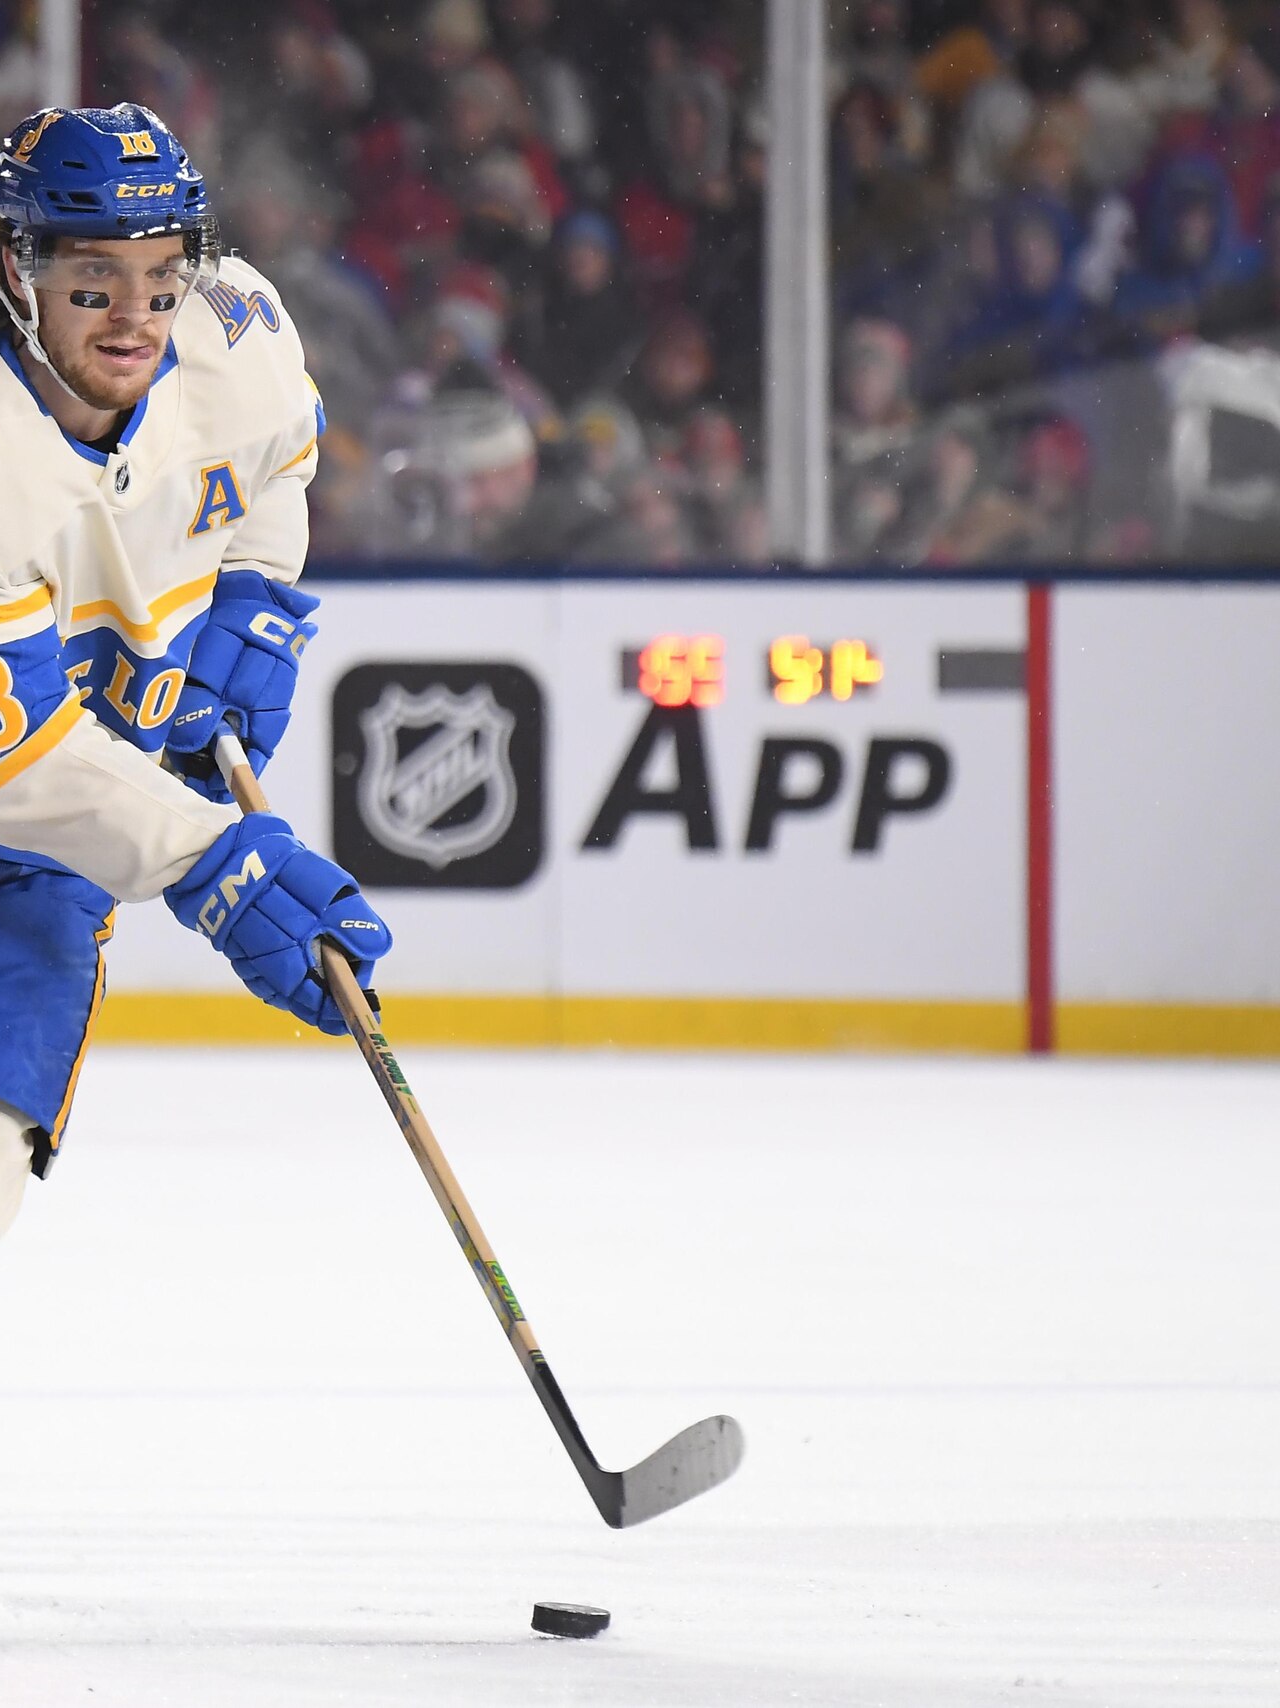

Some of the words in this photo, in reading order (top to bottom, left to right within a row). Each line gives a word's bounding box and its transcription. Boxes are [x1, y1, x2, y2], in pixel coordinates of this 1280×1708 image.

[119, 131, 156, 155] 18
[116, 183, 176, 198] CCM
[188, 460, 249, 539] A
[174, 705, 213, 727] CCM
[196, 849, 267, 940] CM
[340, 920, 379, 932] CCM
